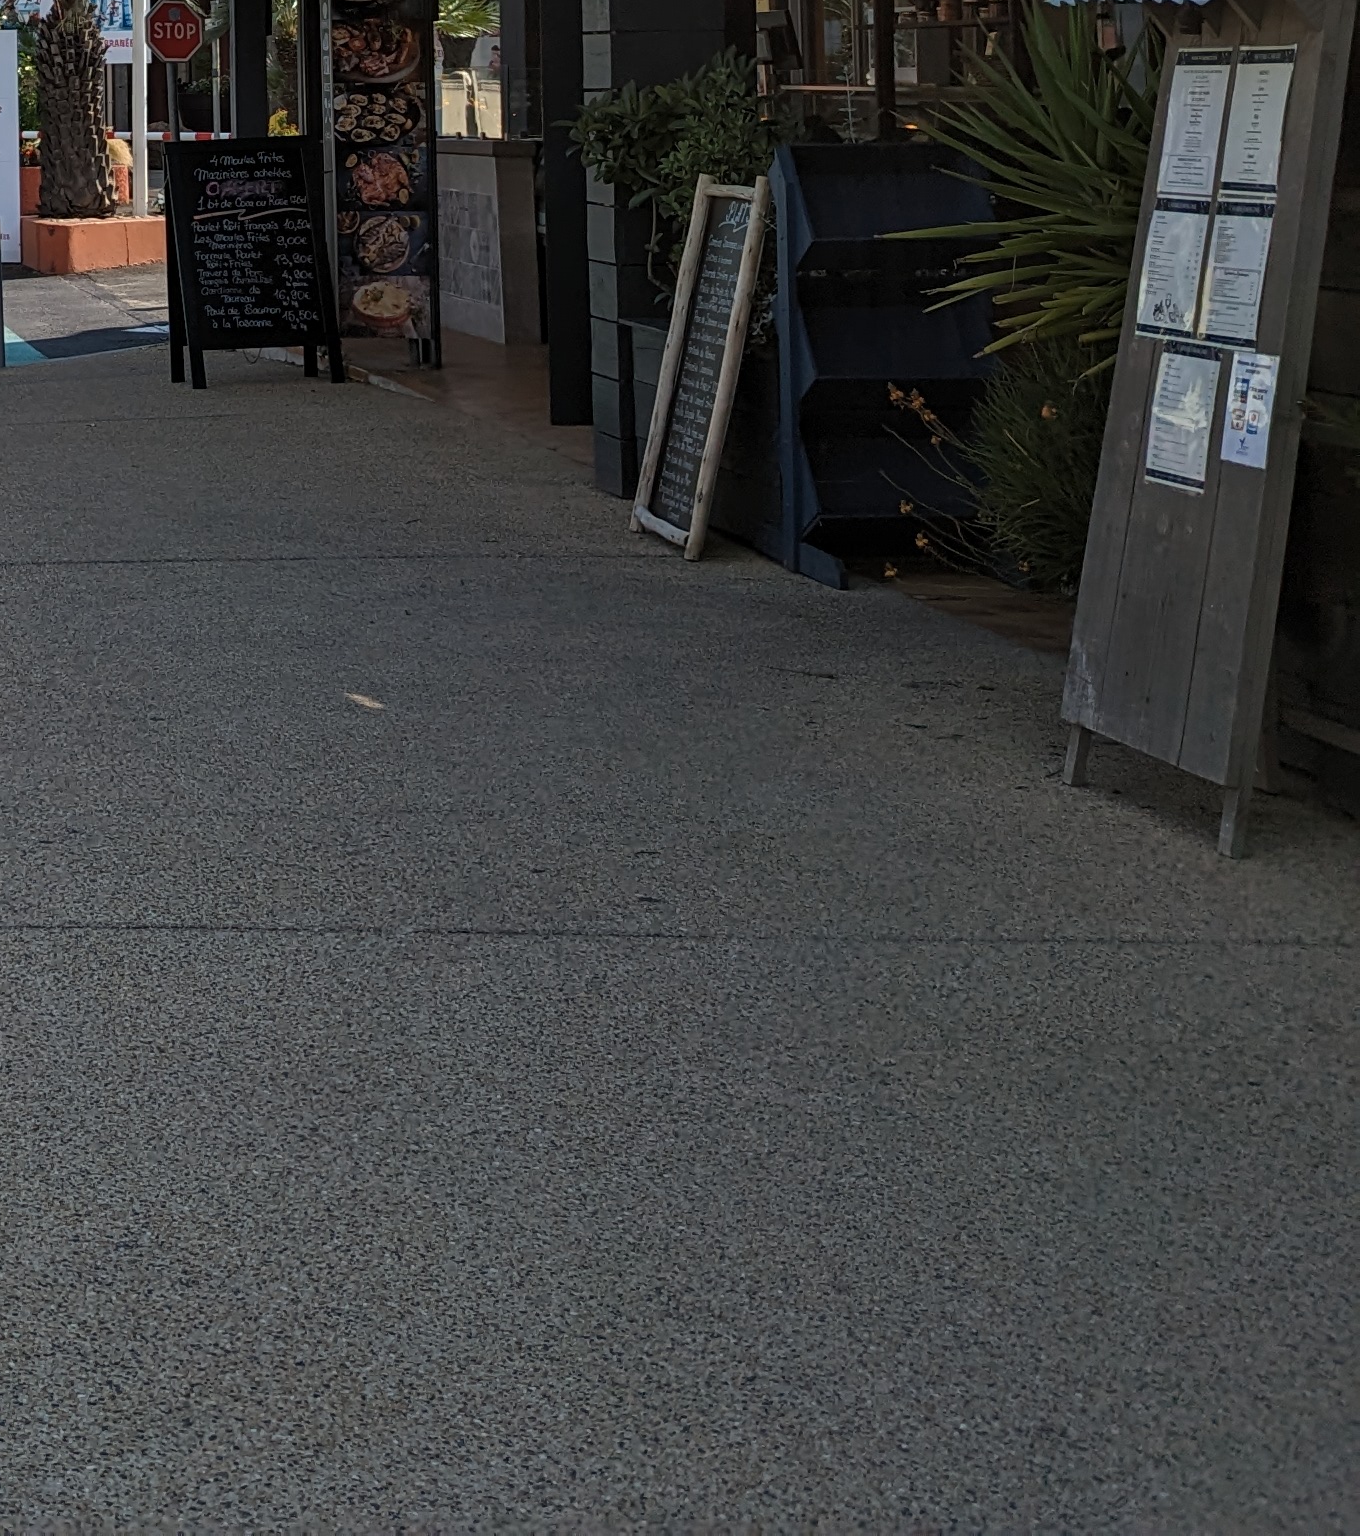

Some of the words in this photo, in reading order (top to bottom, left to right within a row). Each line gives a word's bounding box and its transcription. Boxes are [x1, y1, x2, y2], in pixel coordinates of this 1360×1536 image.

[153, 22, 197, 41] STOP
[209, 155, 218, 167] 4
[220, 155, 256, 166] Moules
[257, 151, 286, 164] Frites
[191, 221, 221, 233] Poulet
[246, 232, 271, 243] Frites
[235, 249, 264, 260] Poulet
[244, 303, 282, 315] Saumon
[281, 310, 320, 324] 15,50€
[222, 318, 231, 329] la
